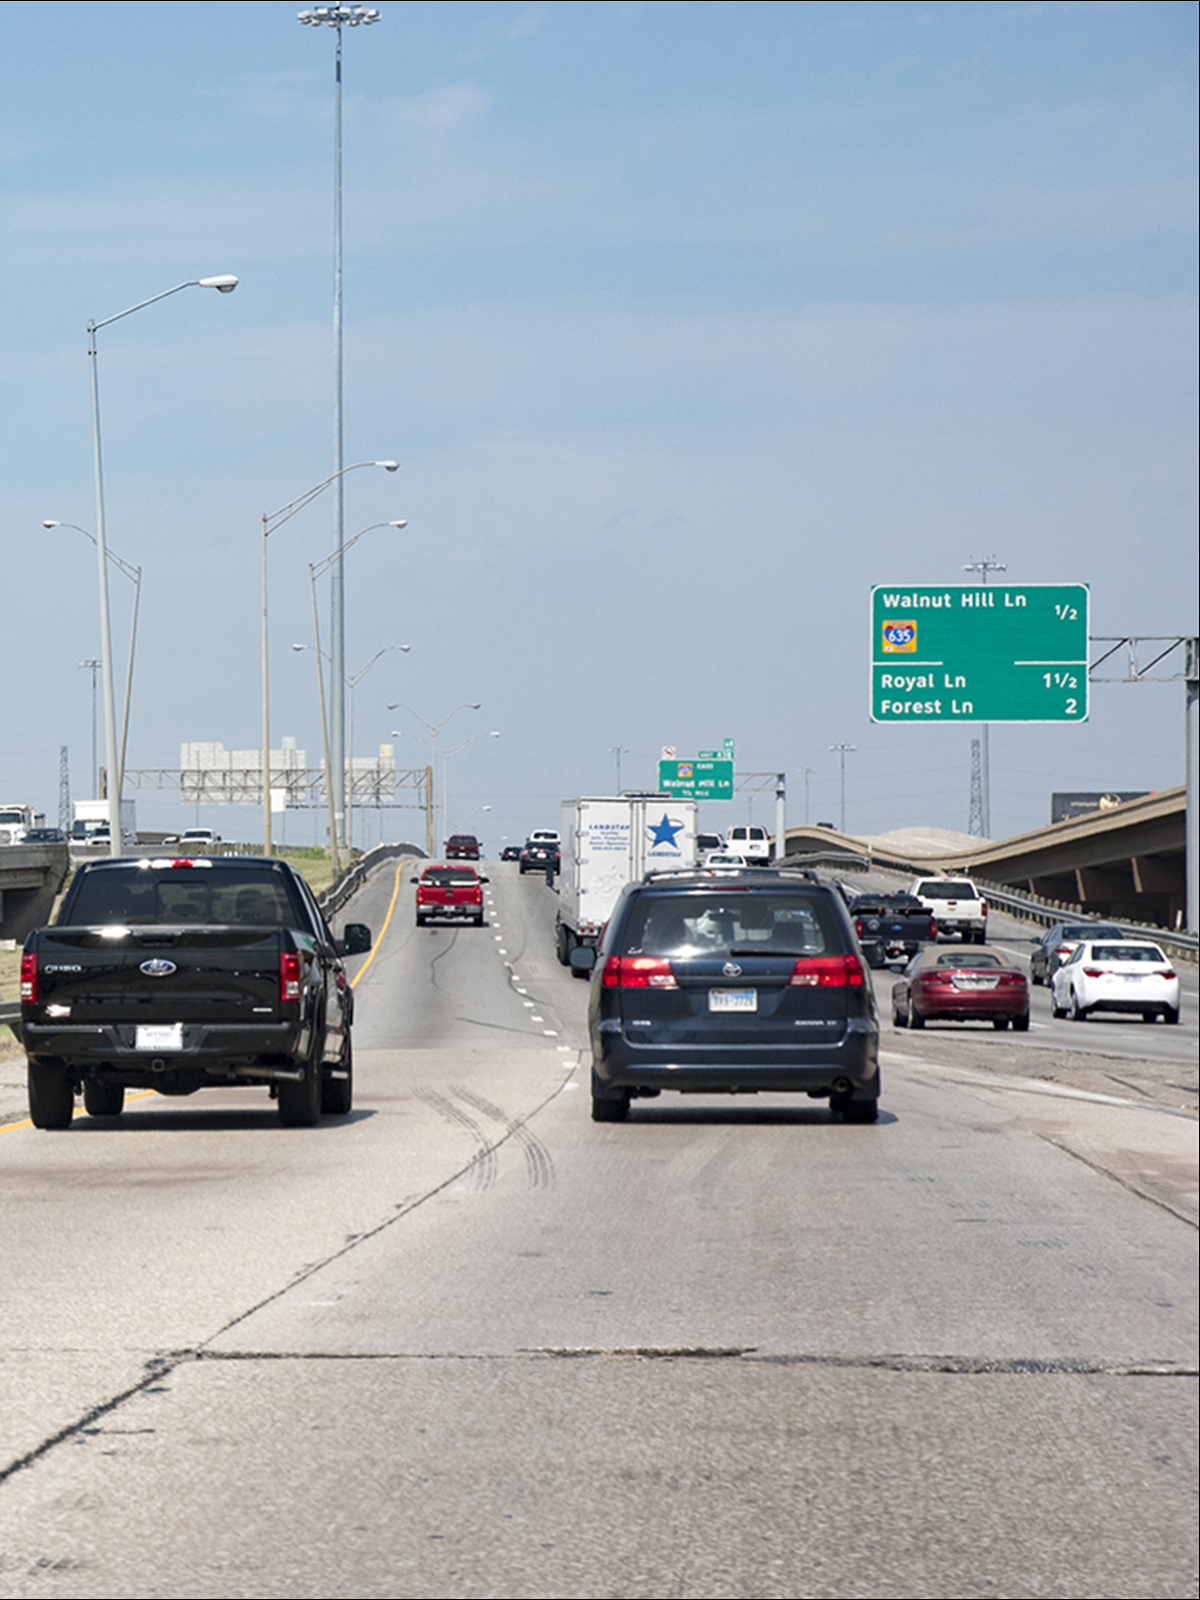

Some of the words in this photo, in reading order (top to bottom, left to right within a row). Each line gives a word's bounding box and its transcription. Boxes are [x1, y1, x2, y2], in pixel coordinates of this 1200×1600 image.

[883, 593, 951, 608] Walnut
[961, 592, 994, 608] Hill
[1004, 593, 1027, 607] Ln
[888, 629, 911, 642] 635
[881, 673, 934, 692] Royal
[944, 673, 966, 688] Ln
[881, 700, 942, 714] Forest
[951, 700, 973, 714] Ln
[1065, 698, 1077, 714] 2
[662, 779, 695, 788] Walnut
[718, 779, 730, 788] Ln
